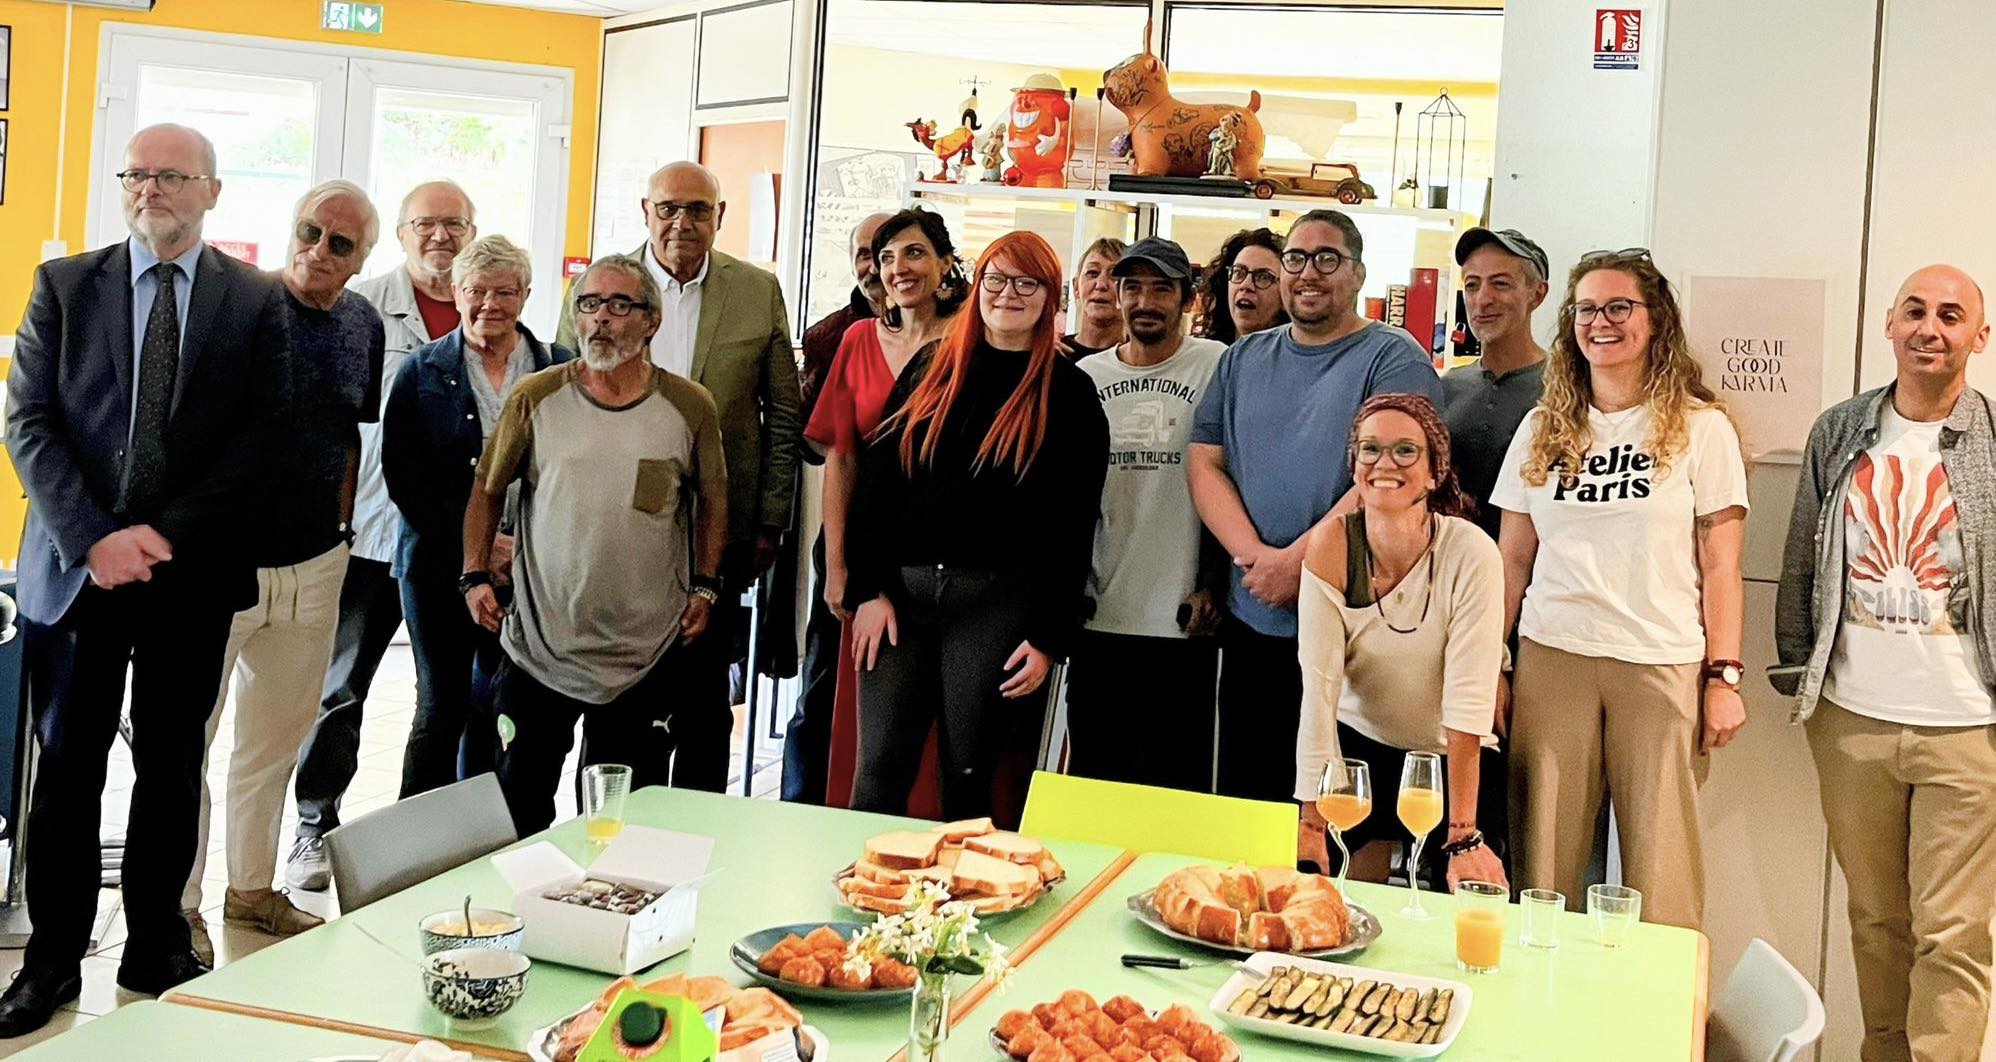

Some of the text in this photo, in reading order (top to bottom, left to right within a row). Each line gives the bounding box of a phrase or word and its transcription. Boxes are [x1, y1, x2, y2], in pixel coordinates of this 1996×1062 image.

[1721, 338, 1790, 356] CREATE
[1727, 357, 1781, 375] GOOD
[1098, 378, 1196, 404] NTERNATIONAL
[1721, 374, 1788, 393] KARMA
[1108, 451, 1182, 465] OTOR TRUCKS
[1553, 472, 1650, 502] Paris
